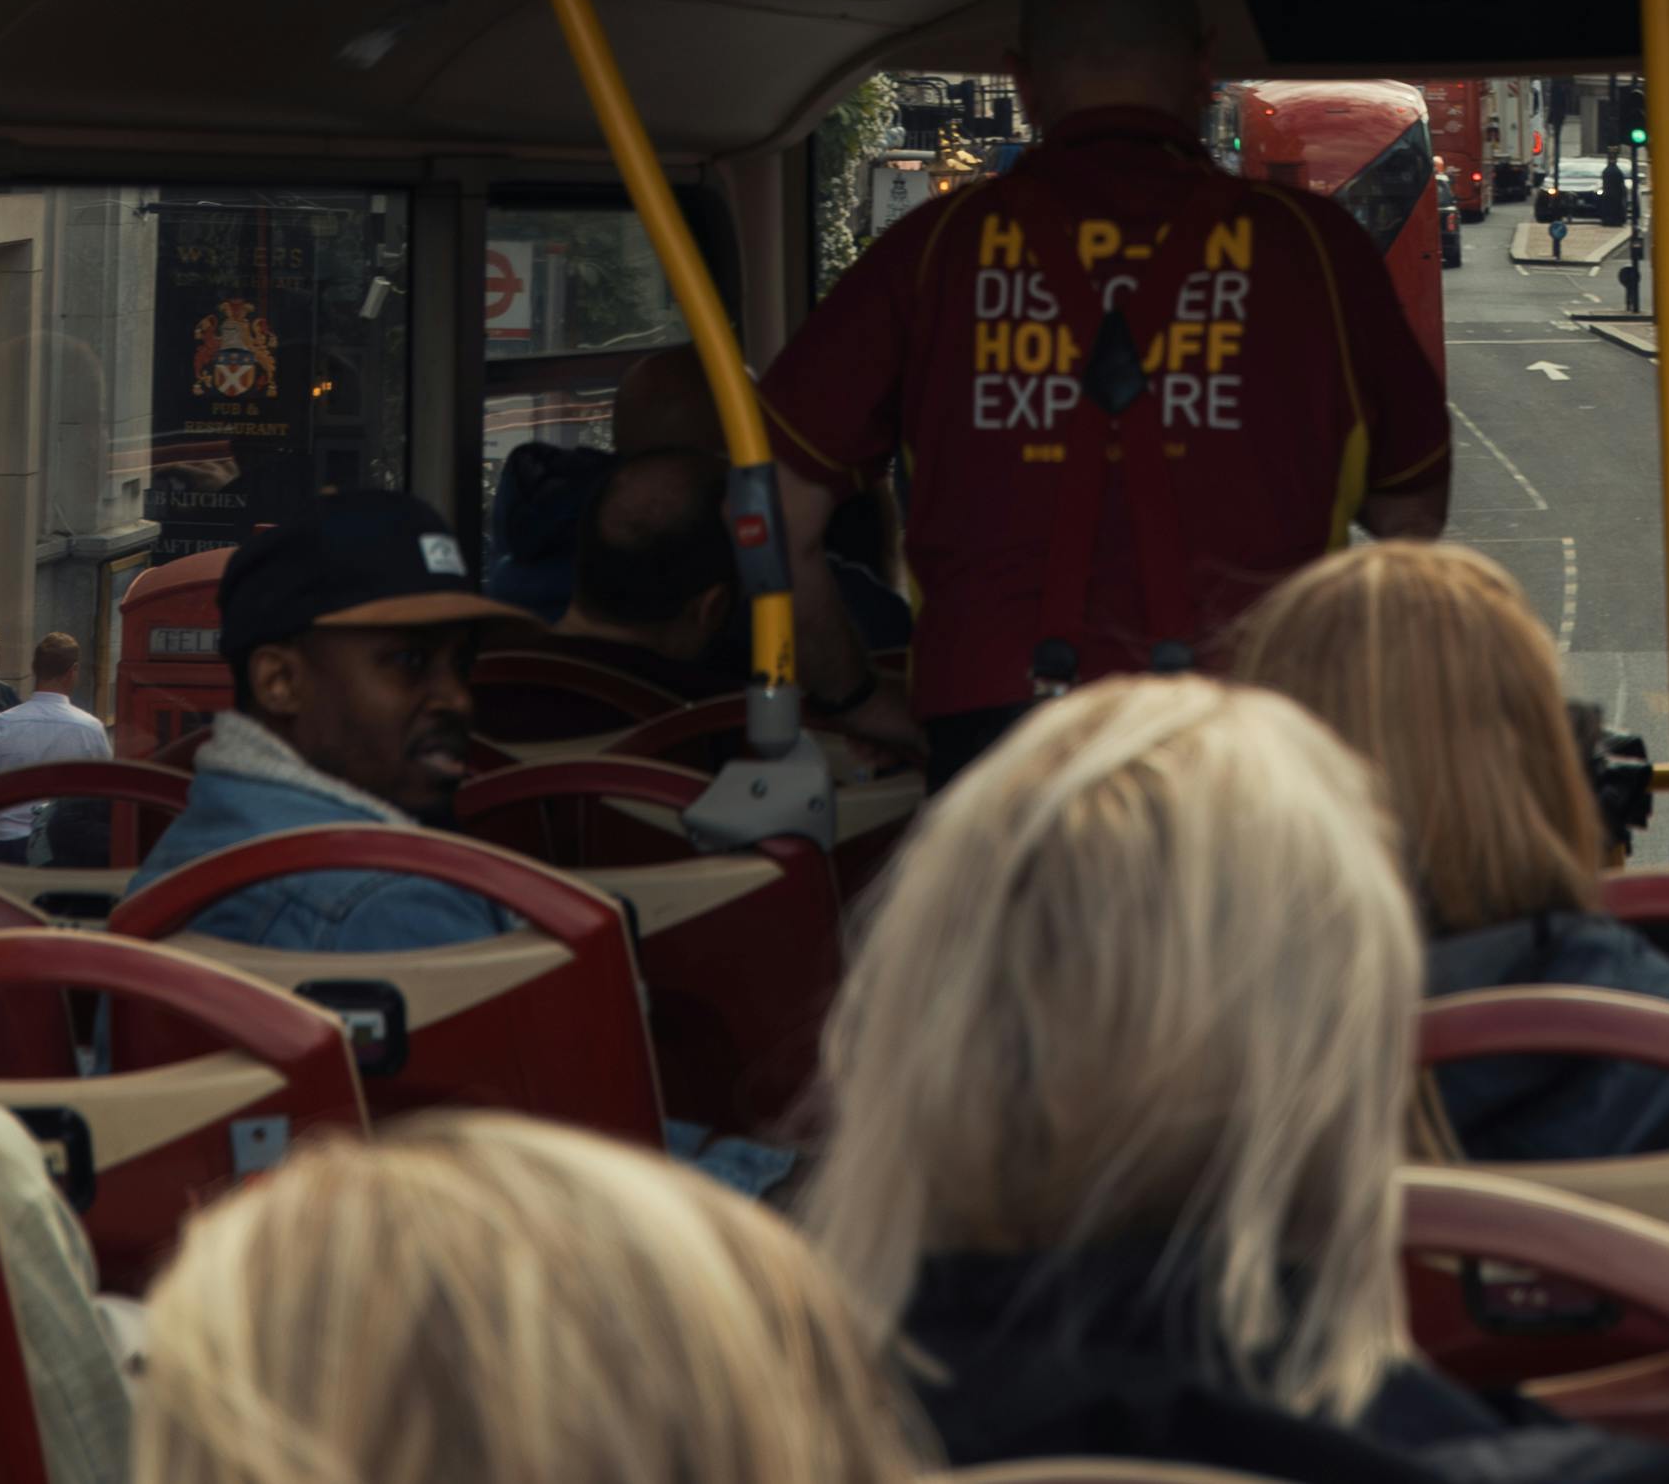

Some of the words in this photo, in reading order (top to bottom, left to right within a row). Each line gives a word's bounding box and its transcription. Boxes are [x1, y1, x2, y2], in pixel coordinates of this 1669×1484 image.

[977, 214, 1254, 272] HP-N
[210, 401, 239, 417] PUB
[971, 373, 1245, 431] EXPRE
[183, 420, 289, 438] RESTAURANT
[169, 491, 249, 509] KITCHEN
